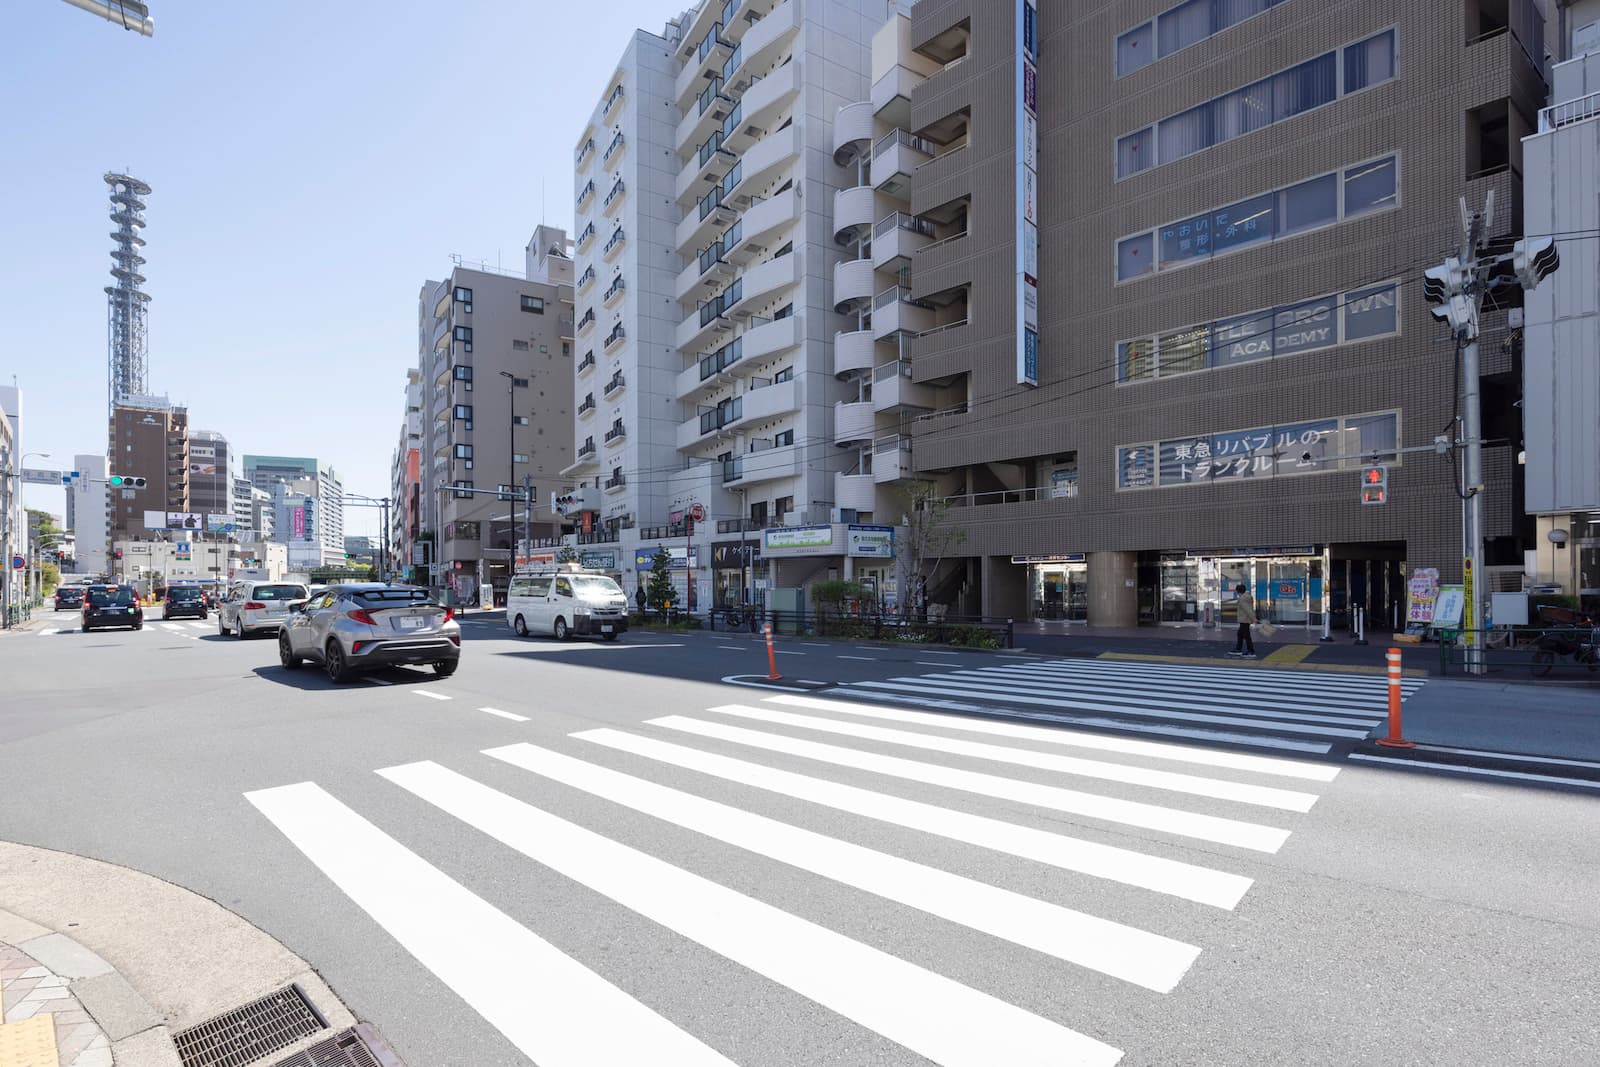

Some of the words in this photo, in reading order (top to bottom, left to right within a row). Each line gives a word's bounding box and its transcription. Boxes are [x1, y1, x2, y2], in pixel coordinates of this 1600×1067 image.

[1230, 327, 1330, 358] ACADEMY
[1175, 430, 1320, 460] 東急リバブルの
